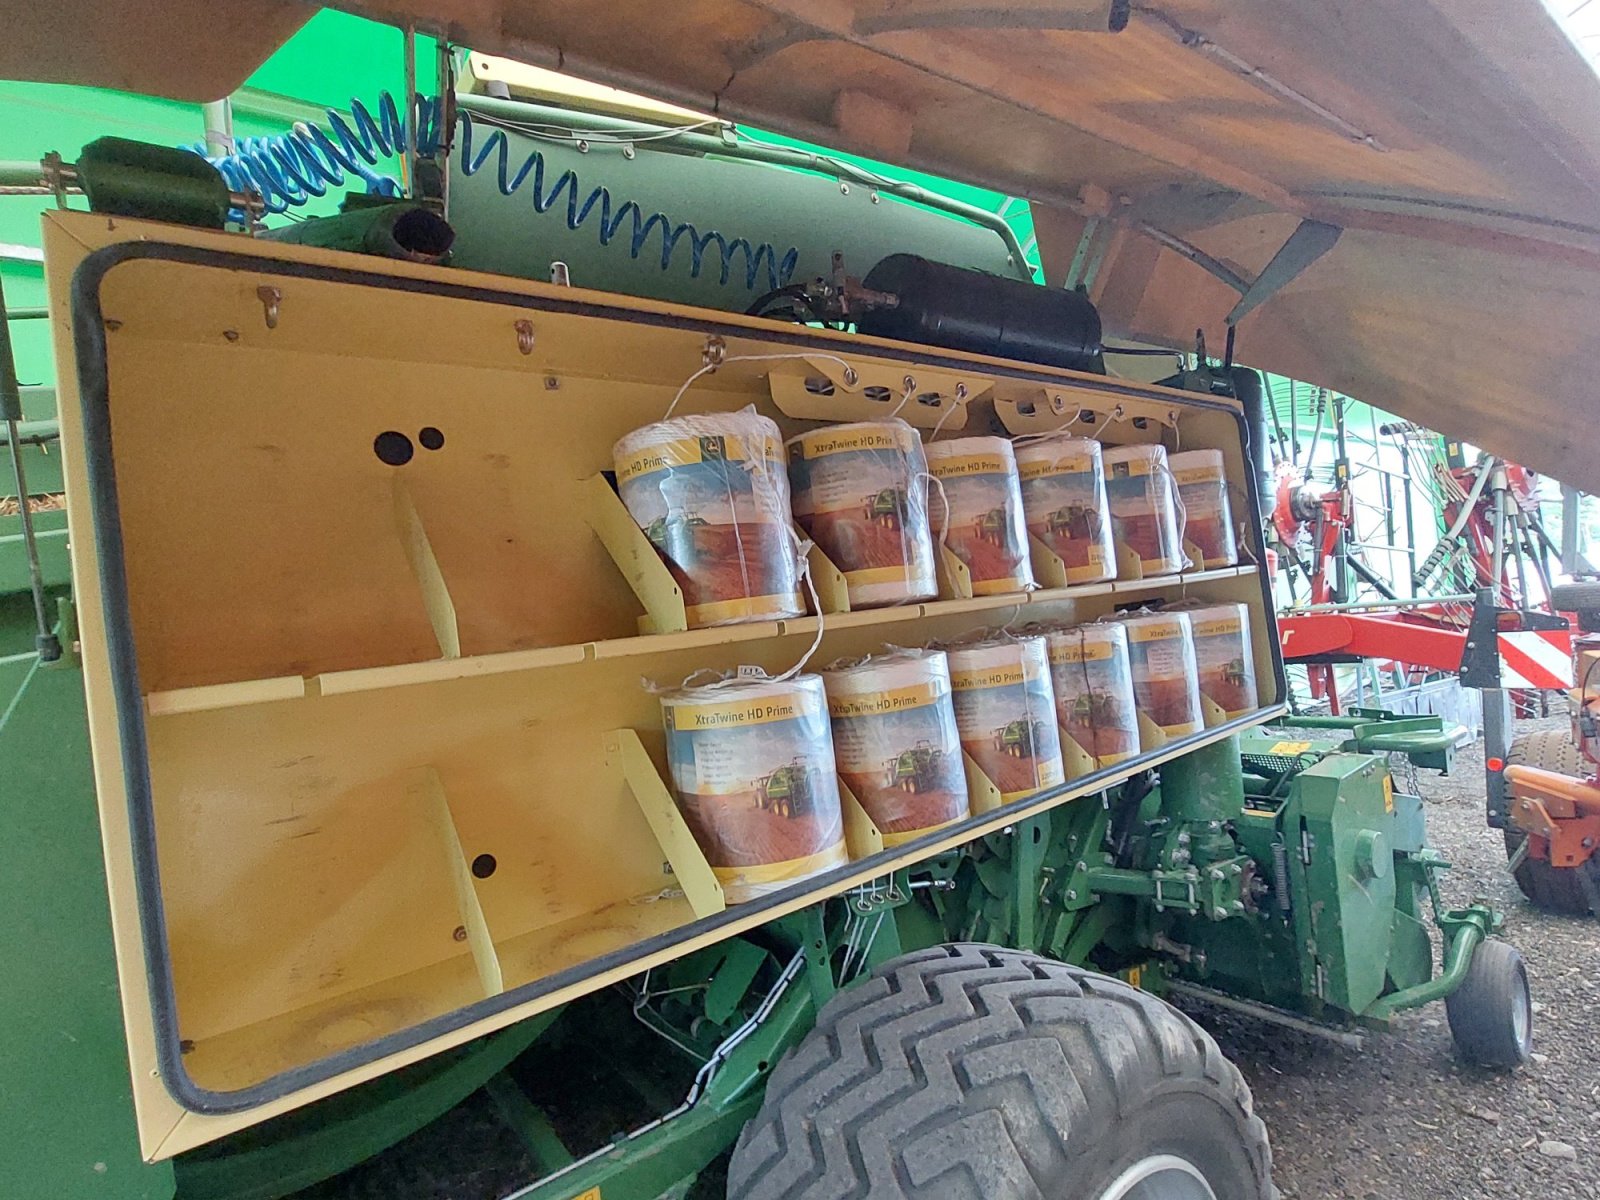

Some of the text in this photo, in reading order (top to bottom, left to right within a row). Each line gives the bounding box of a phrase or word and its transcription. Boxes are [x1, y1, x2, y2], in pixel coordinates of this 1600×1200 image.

[814, 439, 858, 454] XtraTwine
[860, 436, 874, 447] HD
[631, 459, 642, 473] HD
[967, 462, 980, 472] HD
[981, 461, 1001, 471] Prime
[1281, 629, 1295, 645] r
[989, 674, 1002, 684] HD
[833, 696, 917, 714] XtraTwine HD Prime
[695, 705, 794, 727] XtraTwine HD Prime
